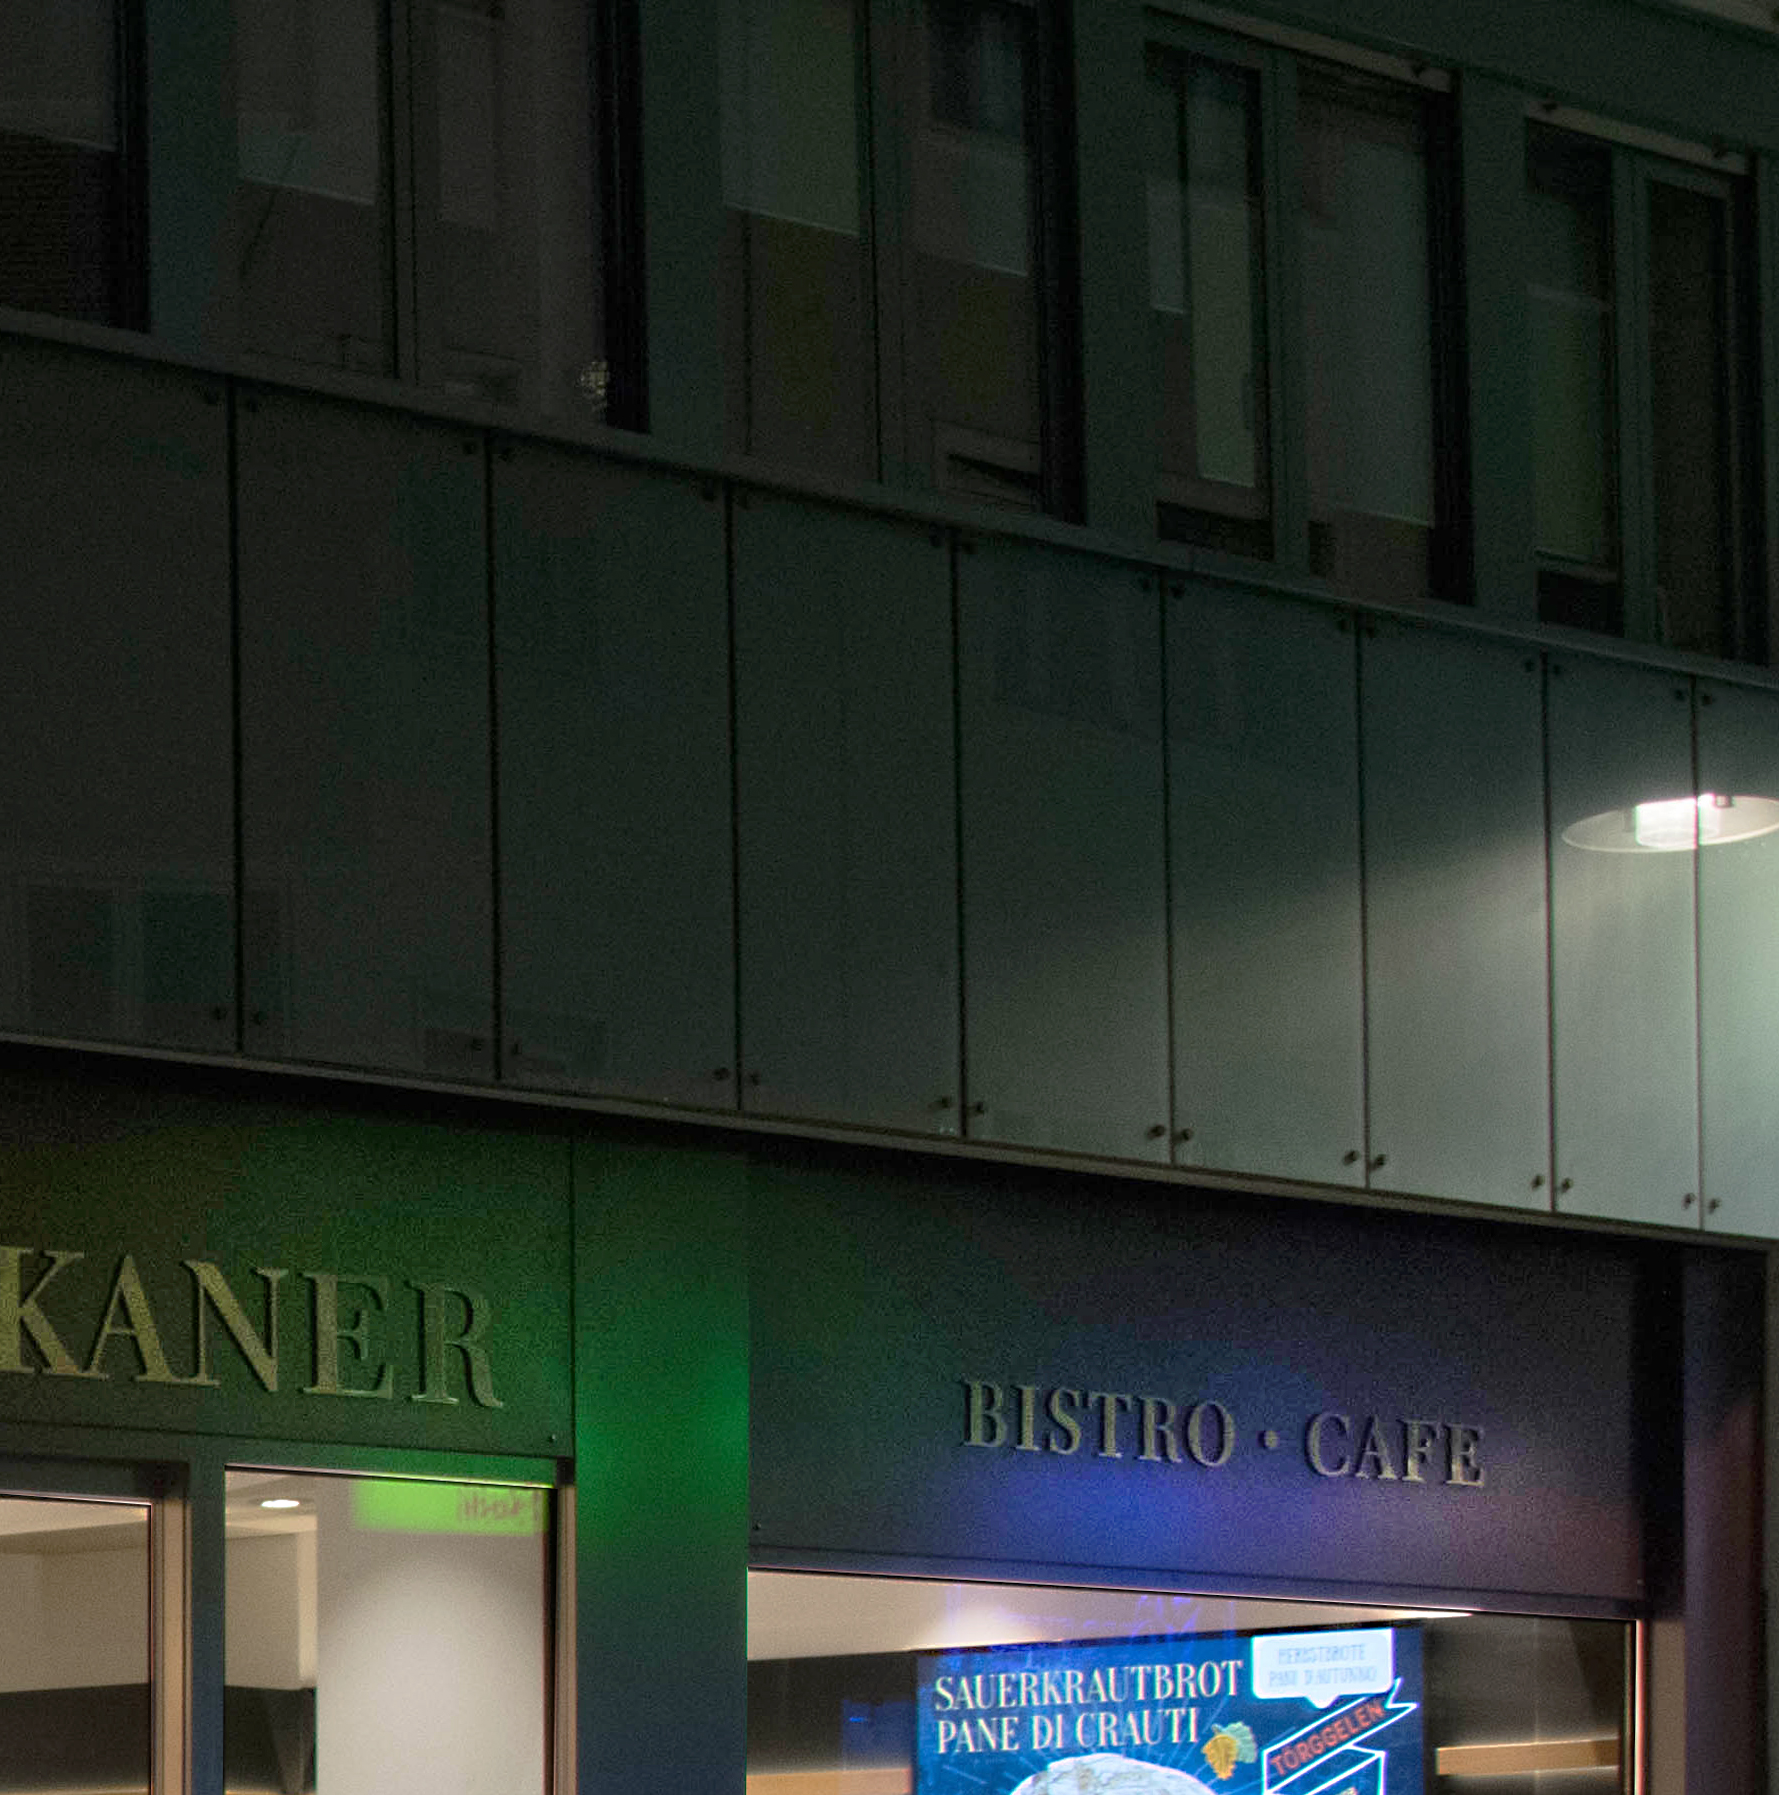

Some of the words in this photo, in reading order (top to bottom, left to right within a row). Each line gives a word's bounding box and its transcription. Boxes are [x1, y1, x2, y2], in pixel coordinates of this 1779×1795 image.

[962, 1378, 1235, 1468] BISTRO
[1305, 1412, 1485, 1488] CAFE
[934, 1659, 1244, 1711] SAUERKRAUTBROT
[936, 1715, 1020, 1753] PANE
[1031, 1713, 1064, 1750] DI
[1075, 1706, 1199, 1747] CRAUTI
[1270, 1699, 1385, 1777] TÖRGGELEN
